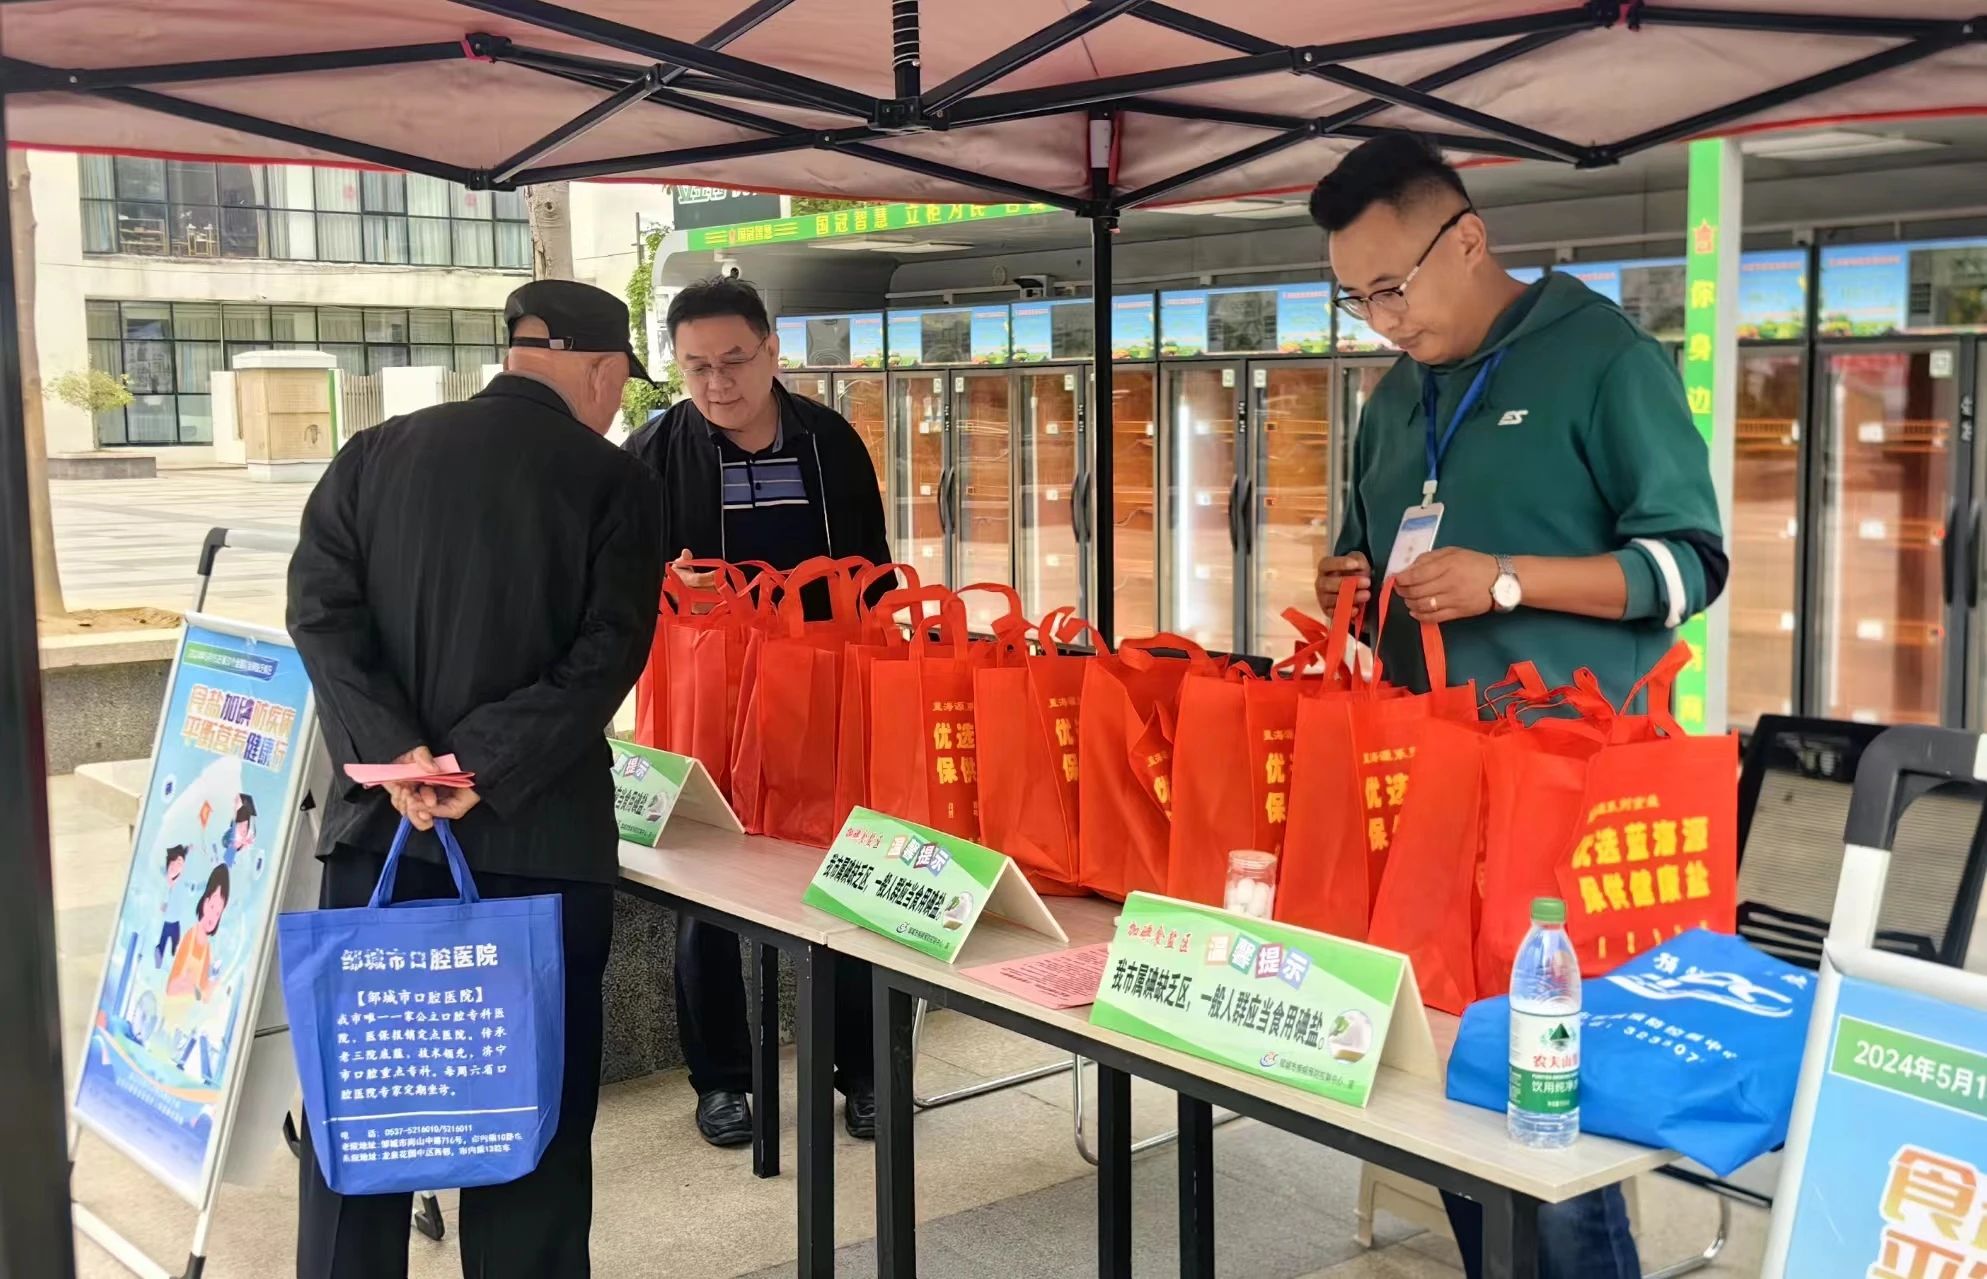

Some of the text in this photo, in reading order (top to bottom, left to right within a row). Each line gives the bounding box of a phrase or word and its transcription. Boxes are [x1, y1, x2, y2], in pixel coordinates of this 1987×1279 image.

[340, 943, 499, 971] 邹城市口腔医院
[1207, 935, 1309, 983] 温馨提示
[357, 986, 484, 1007] 【邹城市口腔医院】
